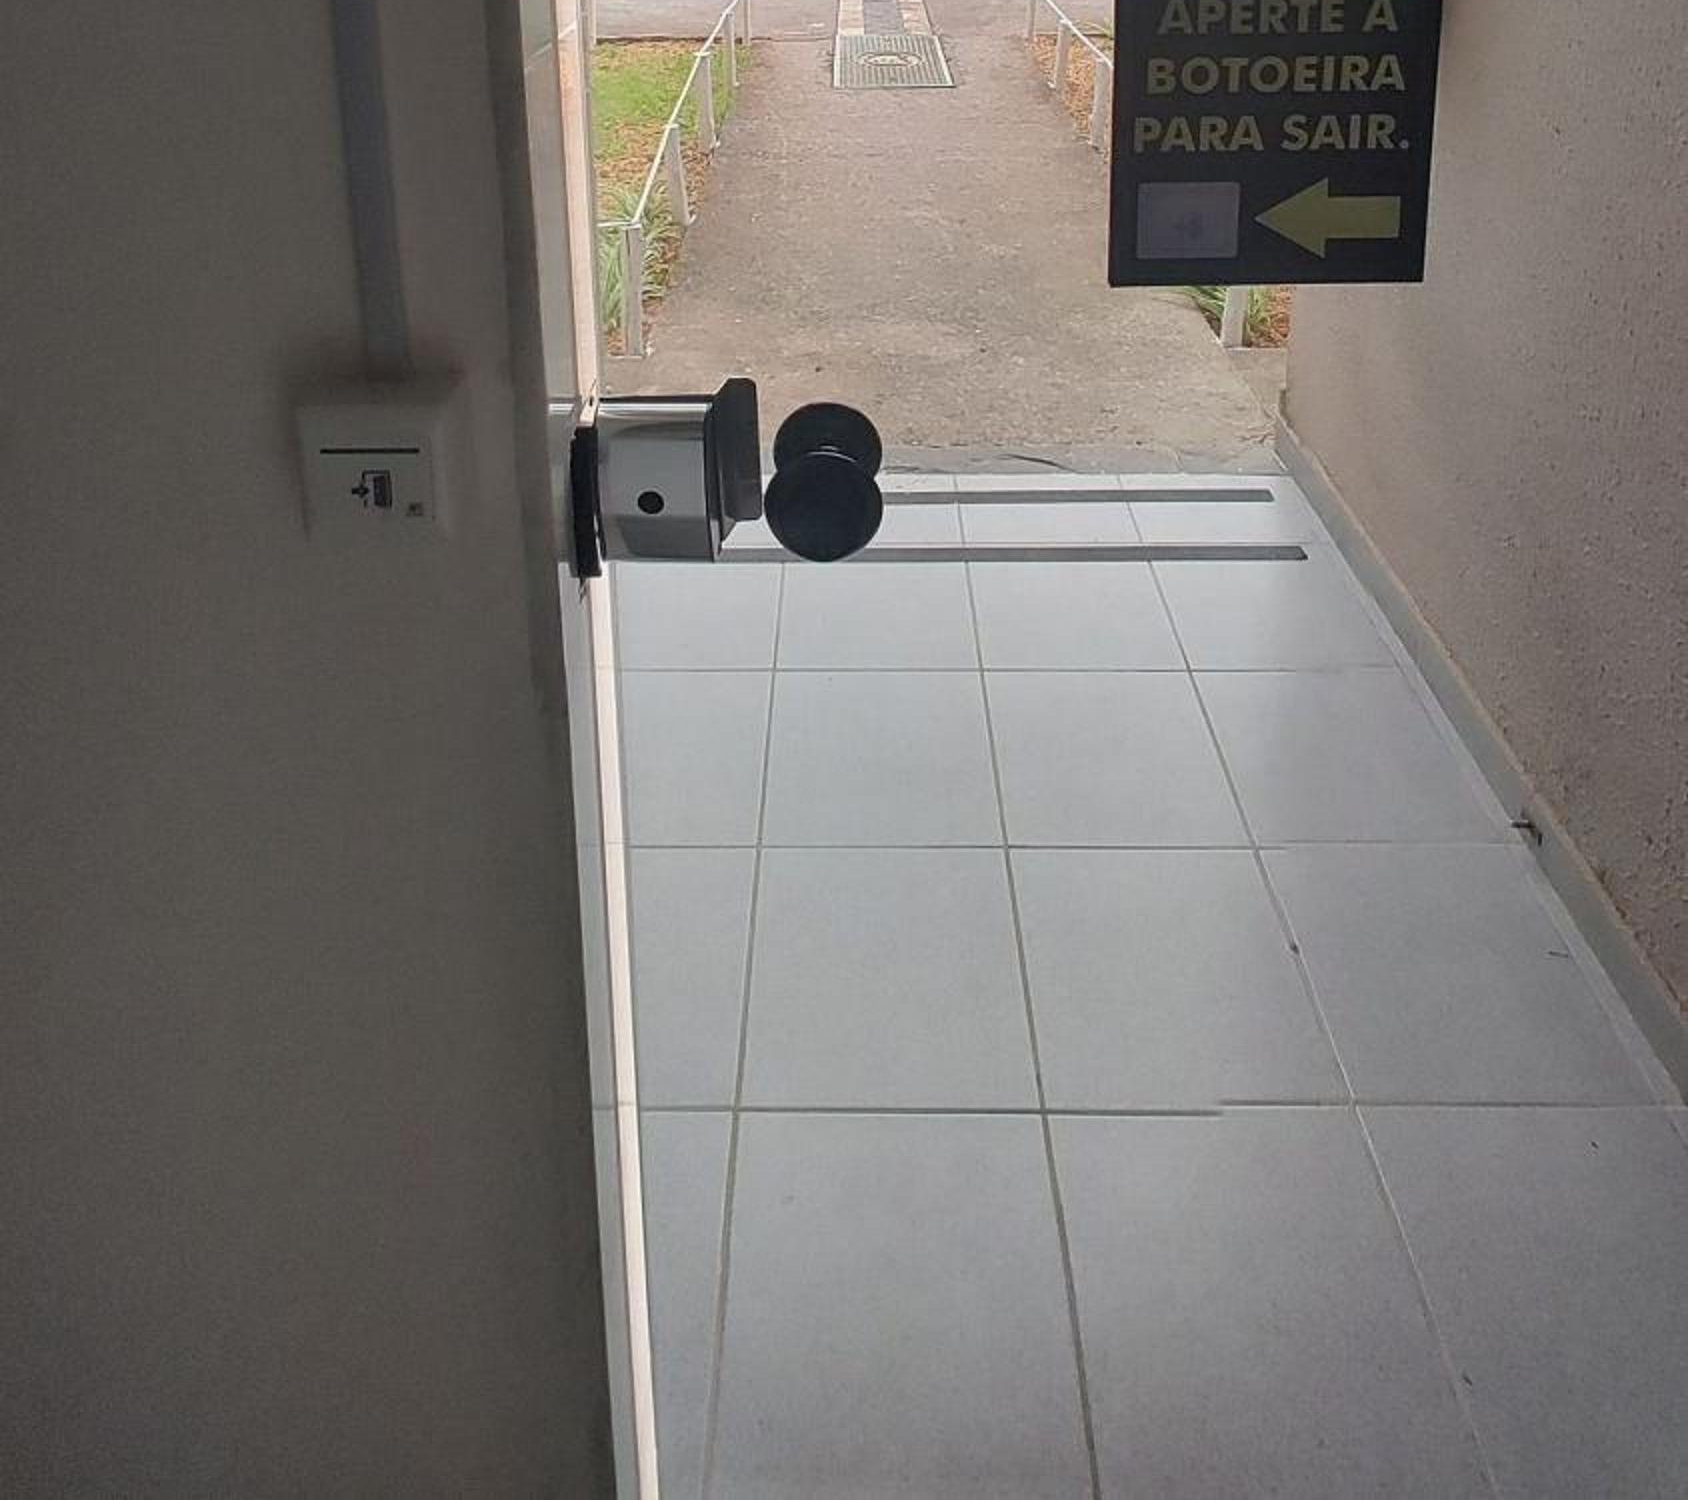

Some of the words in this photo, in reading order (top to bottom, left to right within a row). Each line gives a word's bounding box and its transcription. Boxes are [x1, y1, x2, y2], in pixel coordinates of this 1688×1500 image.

[1147, 54, 1405, 95] BOTOEIRA
[1133, 115, 1265, 153] PARA
[1281, 113, 1410, 151] SAIR.
